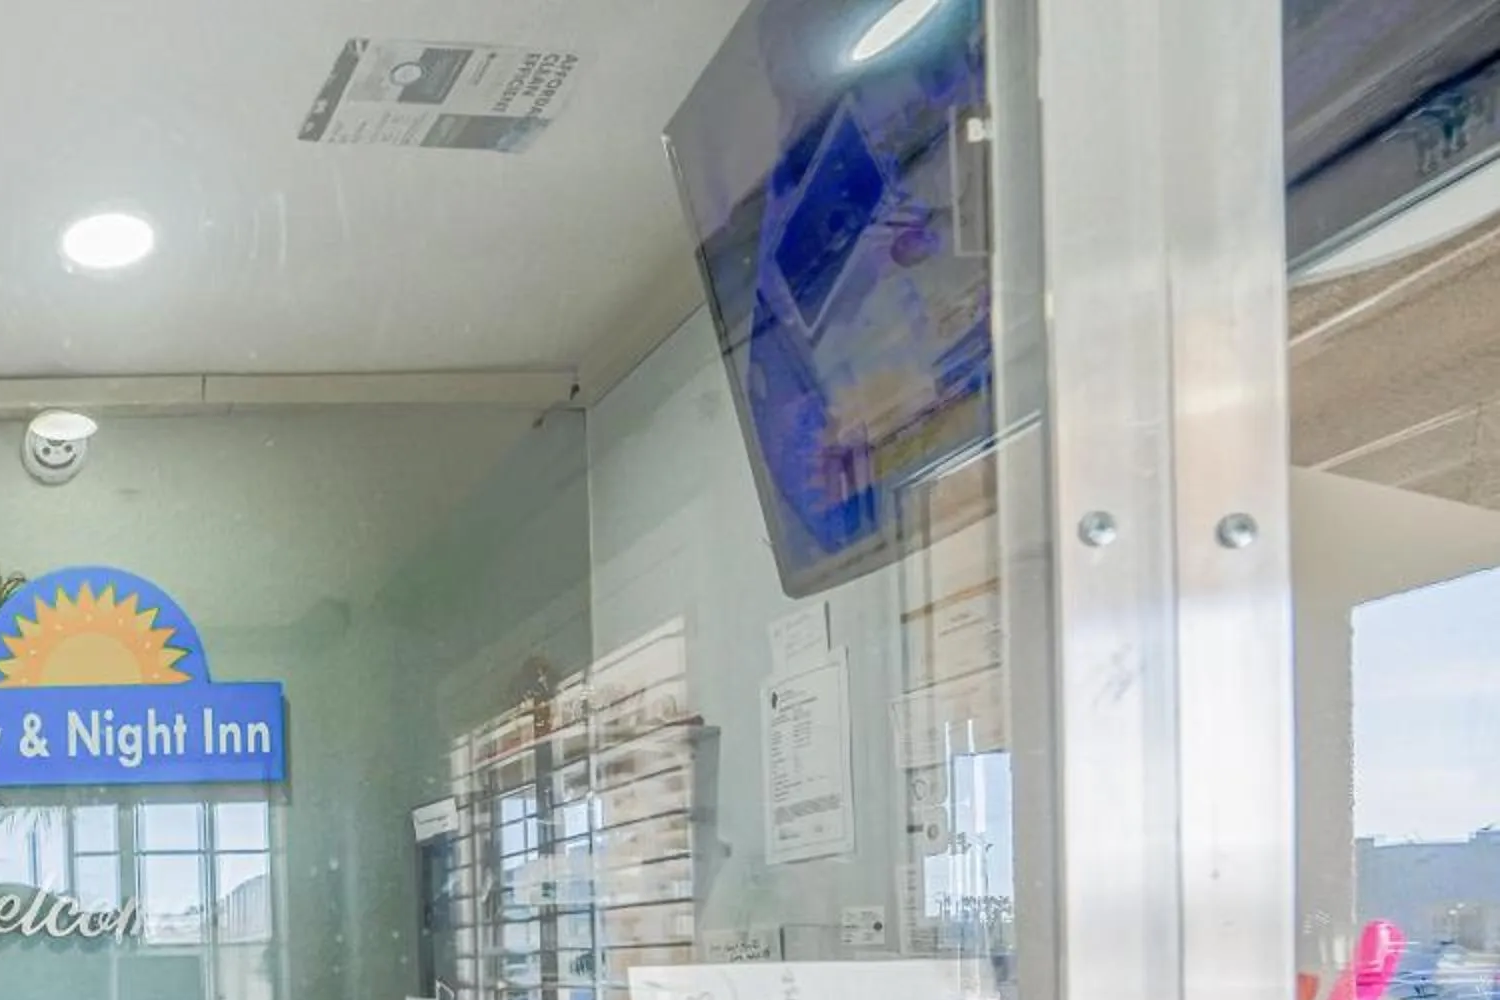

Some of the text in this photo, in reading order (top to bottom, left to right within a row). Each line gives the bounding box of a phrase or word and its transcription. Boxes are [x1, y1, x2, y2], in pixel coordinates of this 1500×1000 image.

[18, 712, 50, 758] &
[67, 707, 187, 768] Night
[203, 707, 271, 756] Inn
